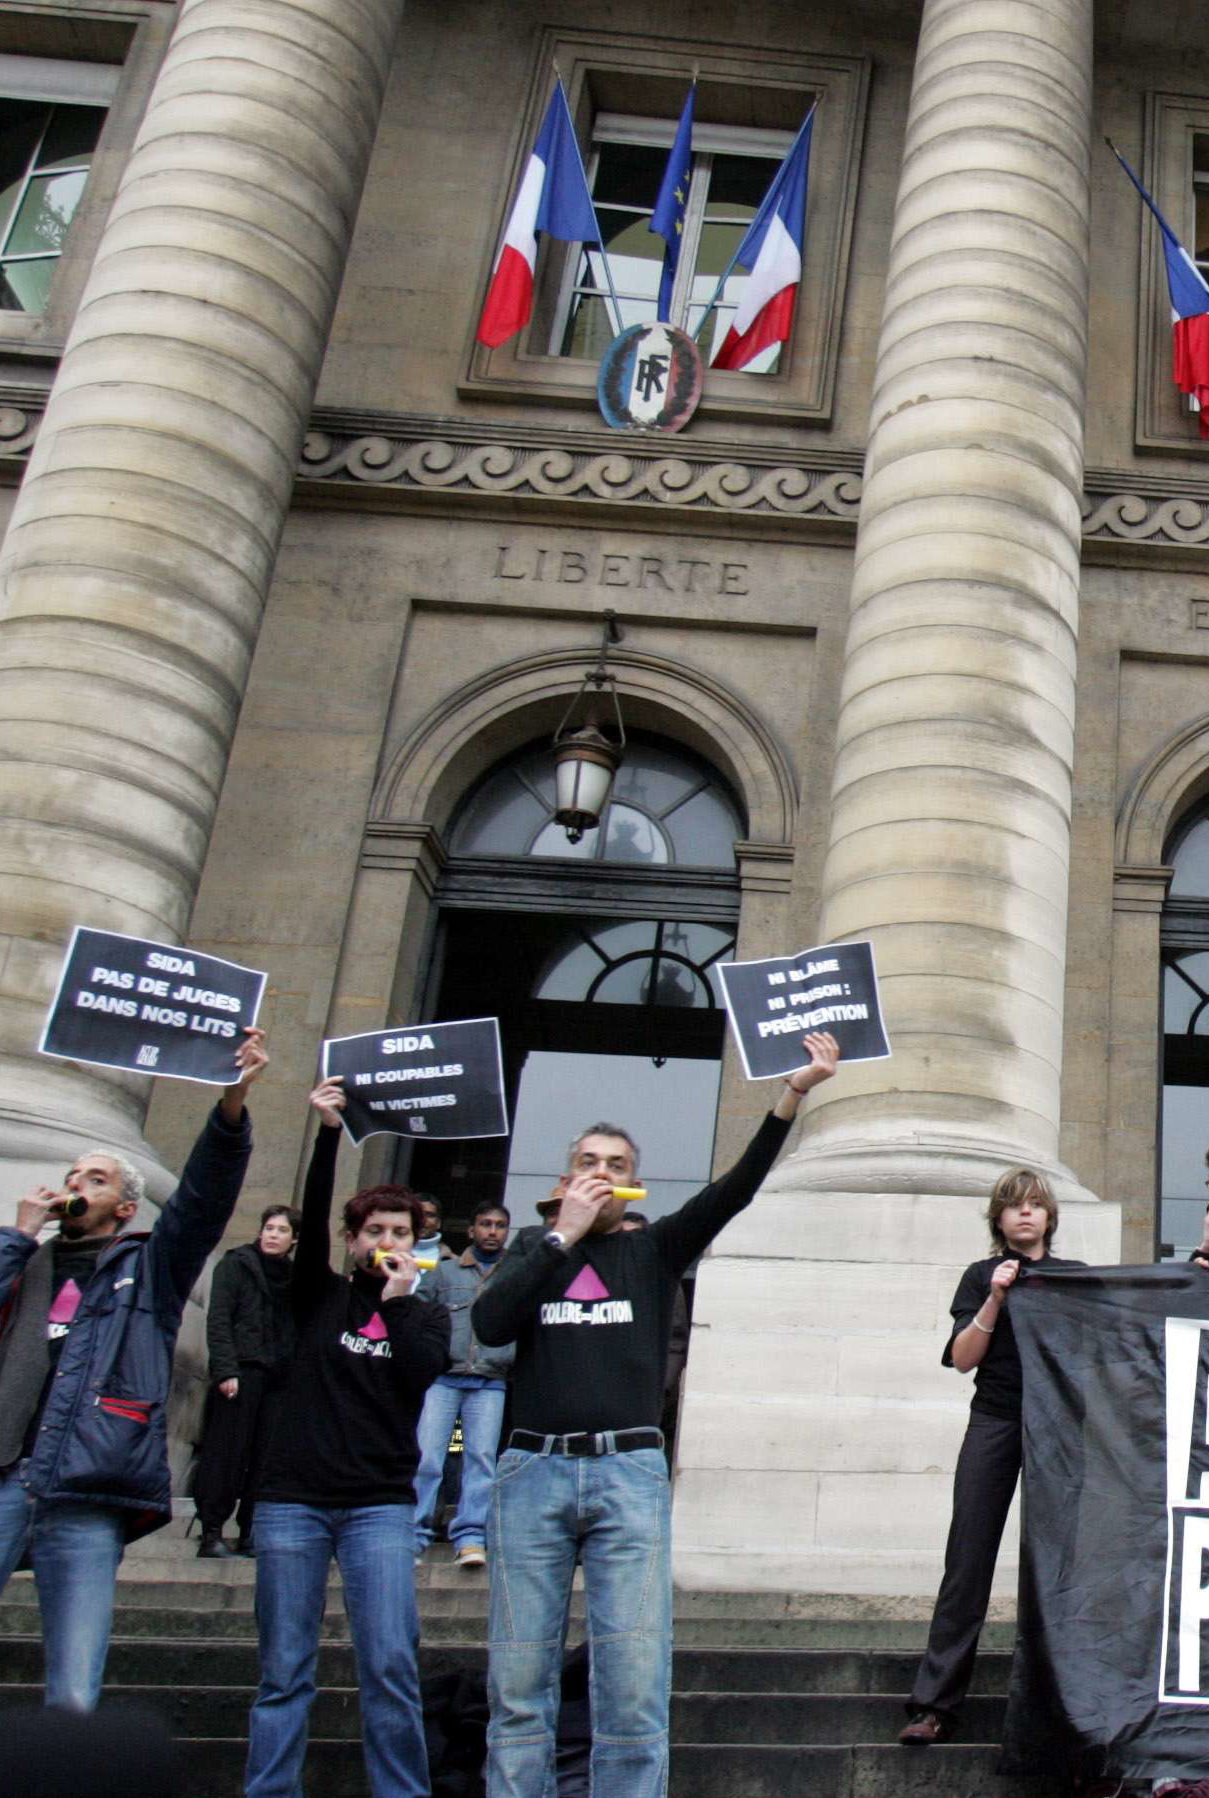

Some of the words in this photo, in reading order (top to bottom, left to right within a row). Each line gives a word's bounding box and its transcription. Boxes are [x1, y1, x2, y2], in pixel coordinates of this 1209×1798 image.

[493, 546, 749, 596] LIBERTE
[146, 952, 195, 975] SIDA
[91, 967, 133, 989] PAS
[137, 977, 170, 996] DE
[173, 985, 240, 1012] JUGES
[767, 972, 785, 984] NI
[767, 996, 785, 1010] NI
[789, 983, 840, 1006] PRISON
[76, 991, 137, 1017] DANS
[141, 1005, 187, 1027] NOS
[190, 1014, 236, 1037] LITS
[757, 1003, 868, 1037] PRÉVENTION
[382, 1034, 434, 1054] SIDA
[355, 1073, 371, 1085] NI
[374, 1063, 463, 1083] COUPABLES
[369, 1100, 385, 1110] NI
[387, 1094, 456, 1110] VICTIMES
[541, 1300, 634, 1324] COLERE=ACTION
